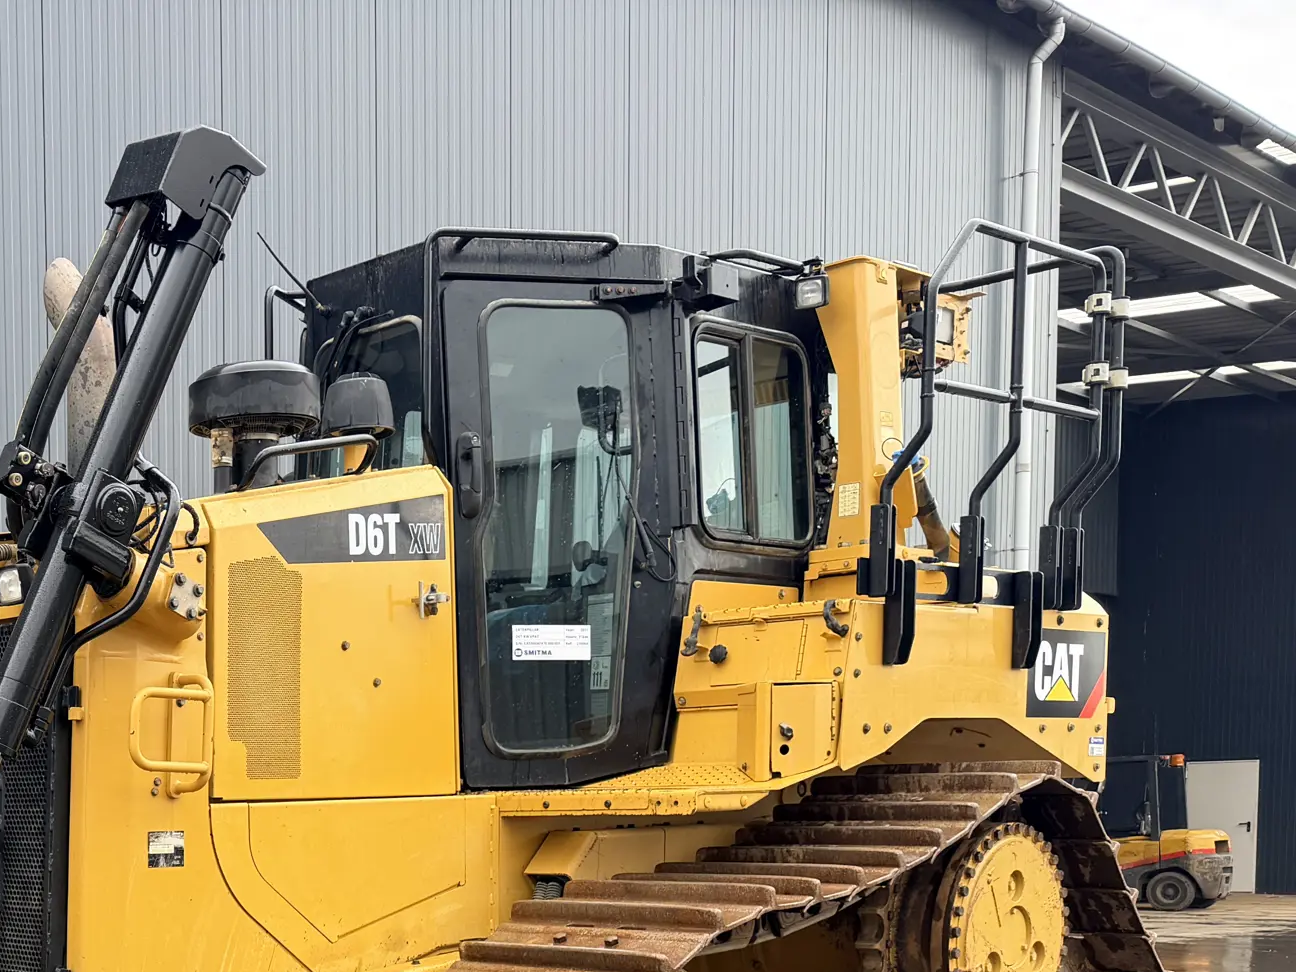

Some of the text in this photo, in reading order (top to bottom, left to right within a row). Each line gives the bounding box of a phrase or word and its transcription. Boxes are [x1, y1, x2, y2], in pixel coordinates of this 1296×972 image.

[348, 513, 441, 556] D6T XW
[1034, 640, 1085, 702] CAT
